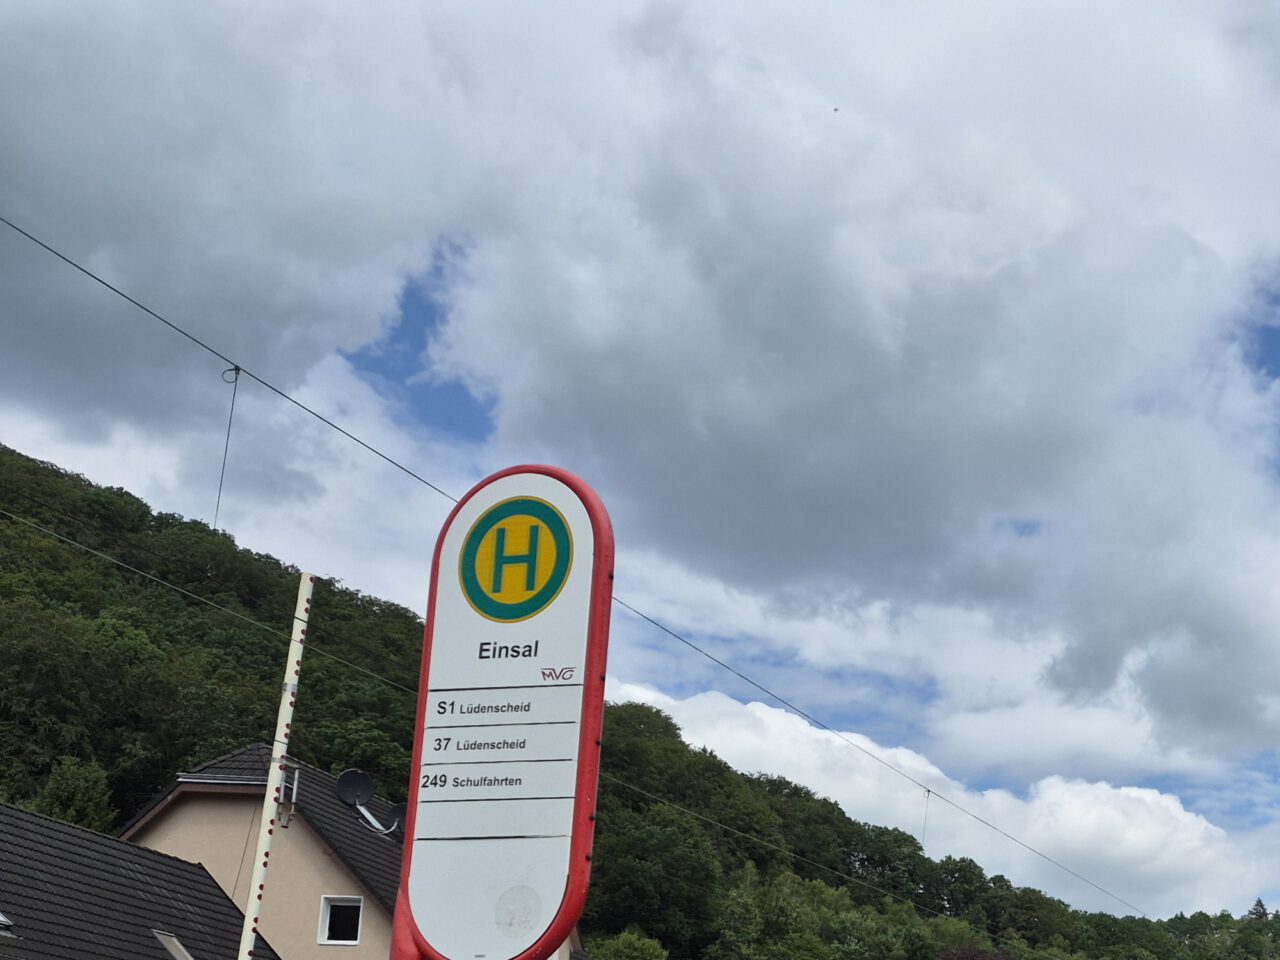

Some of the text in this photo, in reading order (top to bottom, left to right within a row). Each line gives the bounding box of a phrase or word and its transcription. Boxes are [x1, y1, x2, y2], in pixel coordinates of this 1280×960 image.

[491, 524, 540, 594] H
[478, 640, 539, 660] Einsal
[541, 666, 577, 681] MVG
[436, 701, 531, 715] S1 Lüdenscheid
[433, 738, 527, 751] 37 Lüdenscheid
[421, 774, 522, 789] 249 Schulfahrten
